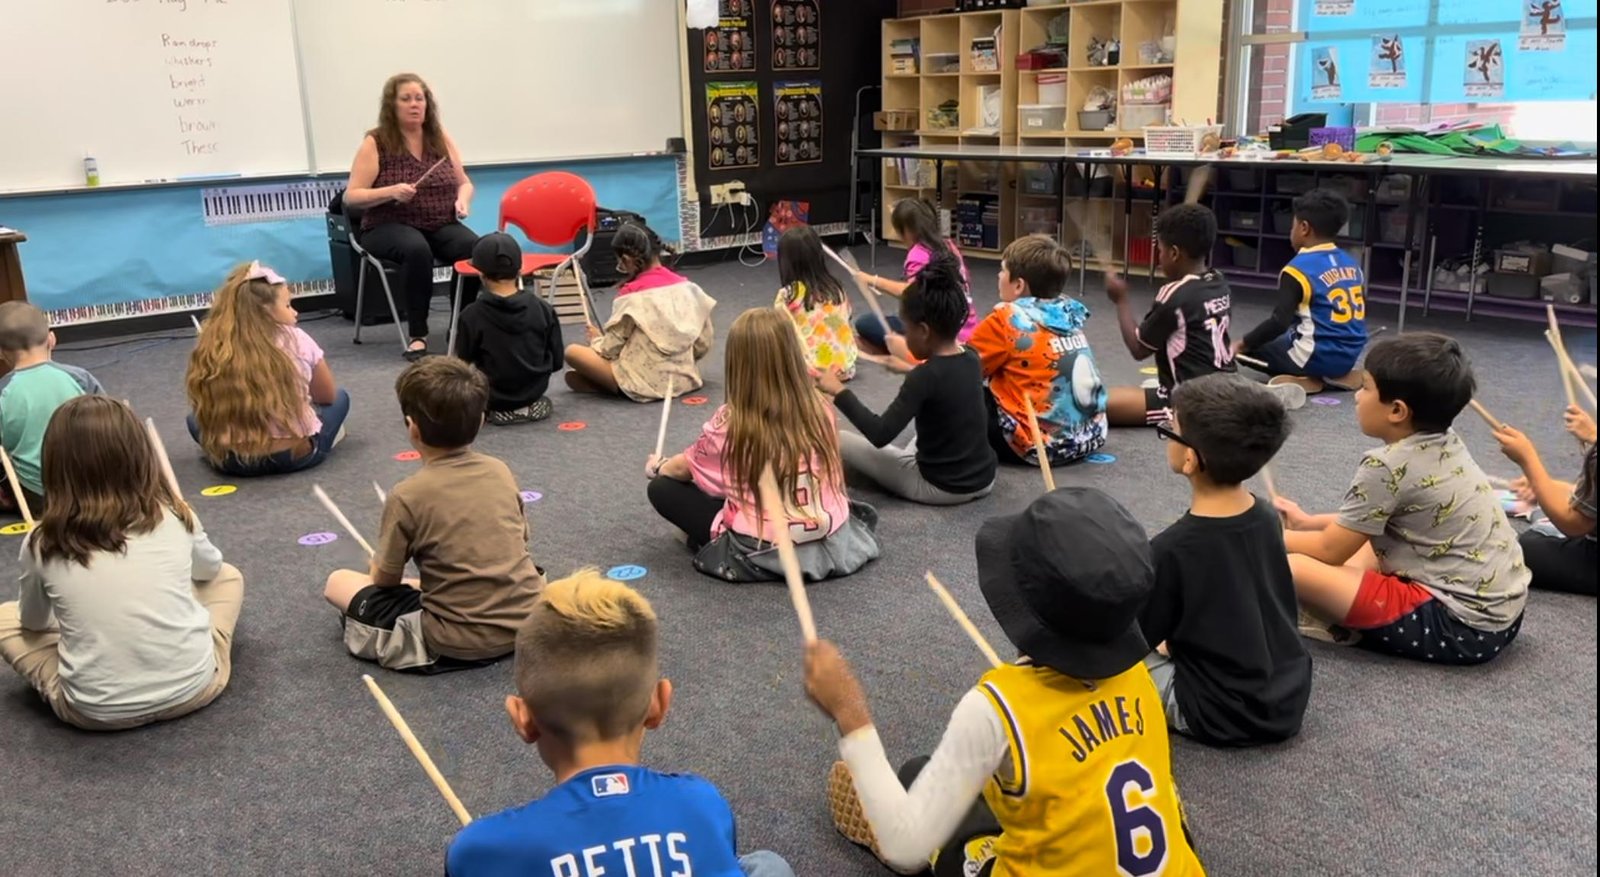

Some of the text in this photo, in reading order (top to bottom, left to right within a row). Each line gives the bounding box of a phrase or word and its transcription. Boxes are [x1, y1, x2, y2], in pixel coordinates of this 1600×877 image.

[1318, 266, 1357, 288] DURANT
[1326, 285, 1365, 324] 35
[1058, 696, 1144, 763] JAMES
[1104, 758, 1168, 877] 6
